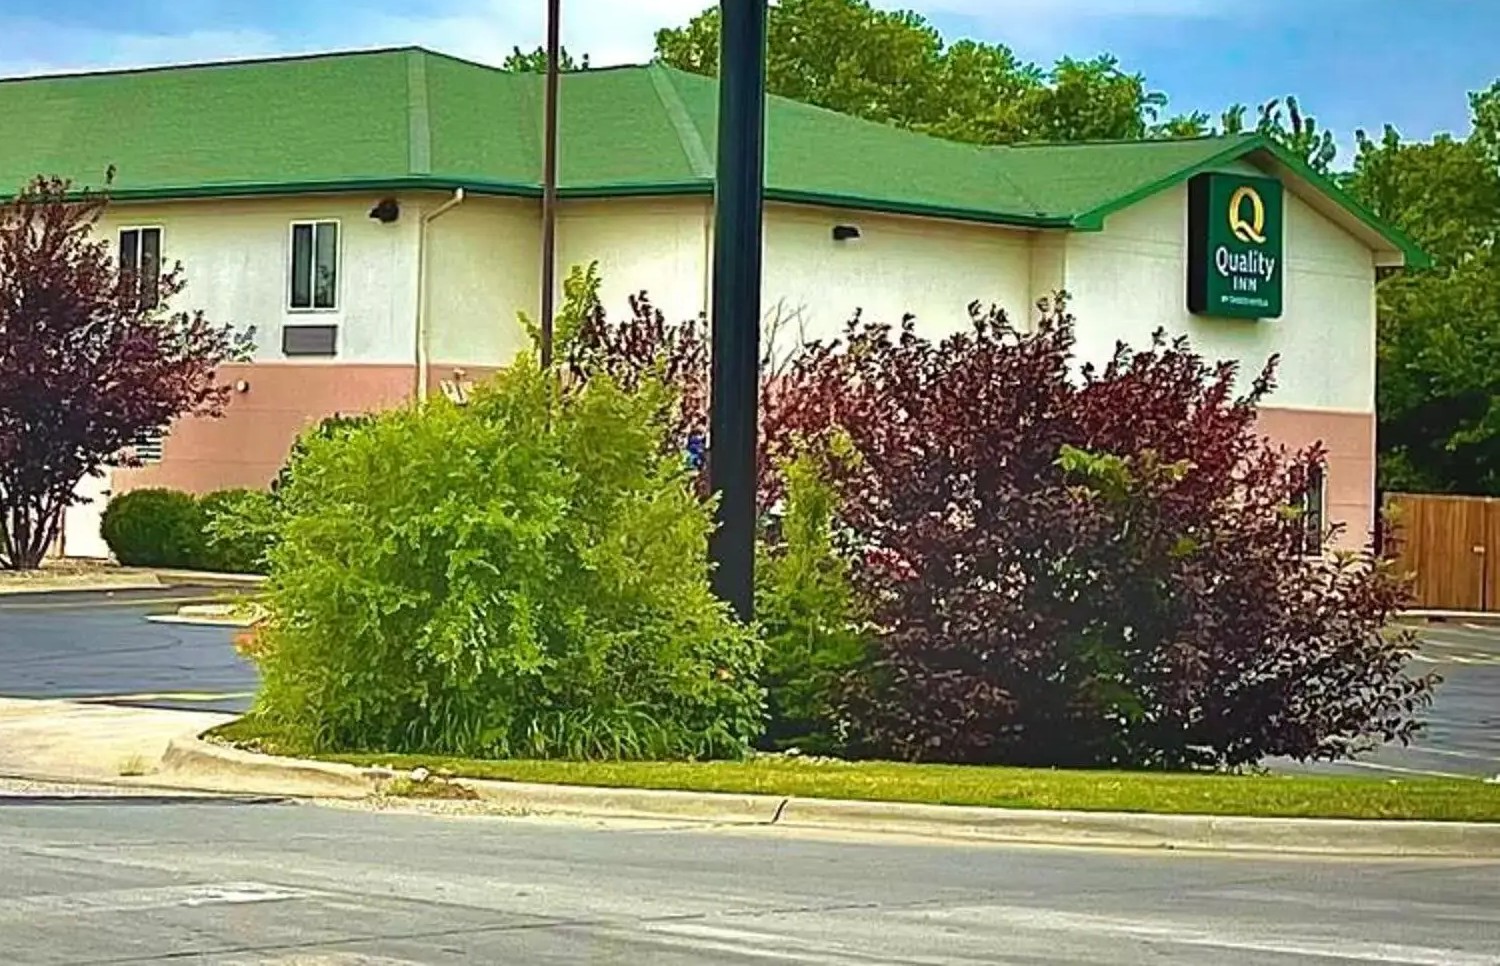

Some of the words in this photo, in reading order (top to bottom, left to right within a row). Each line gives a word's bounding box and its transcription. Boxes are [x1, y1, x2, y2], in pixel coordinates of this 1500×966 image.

[1229, 186, 1266, 242] Q
[1216, 246, 1275, 282] Quality
[1233, 276, 1257, 292] INN
